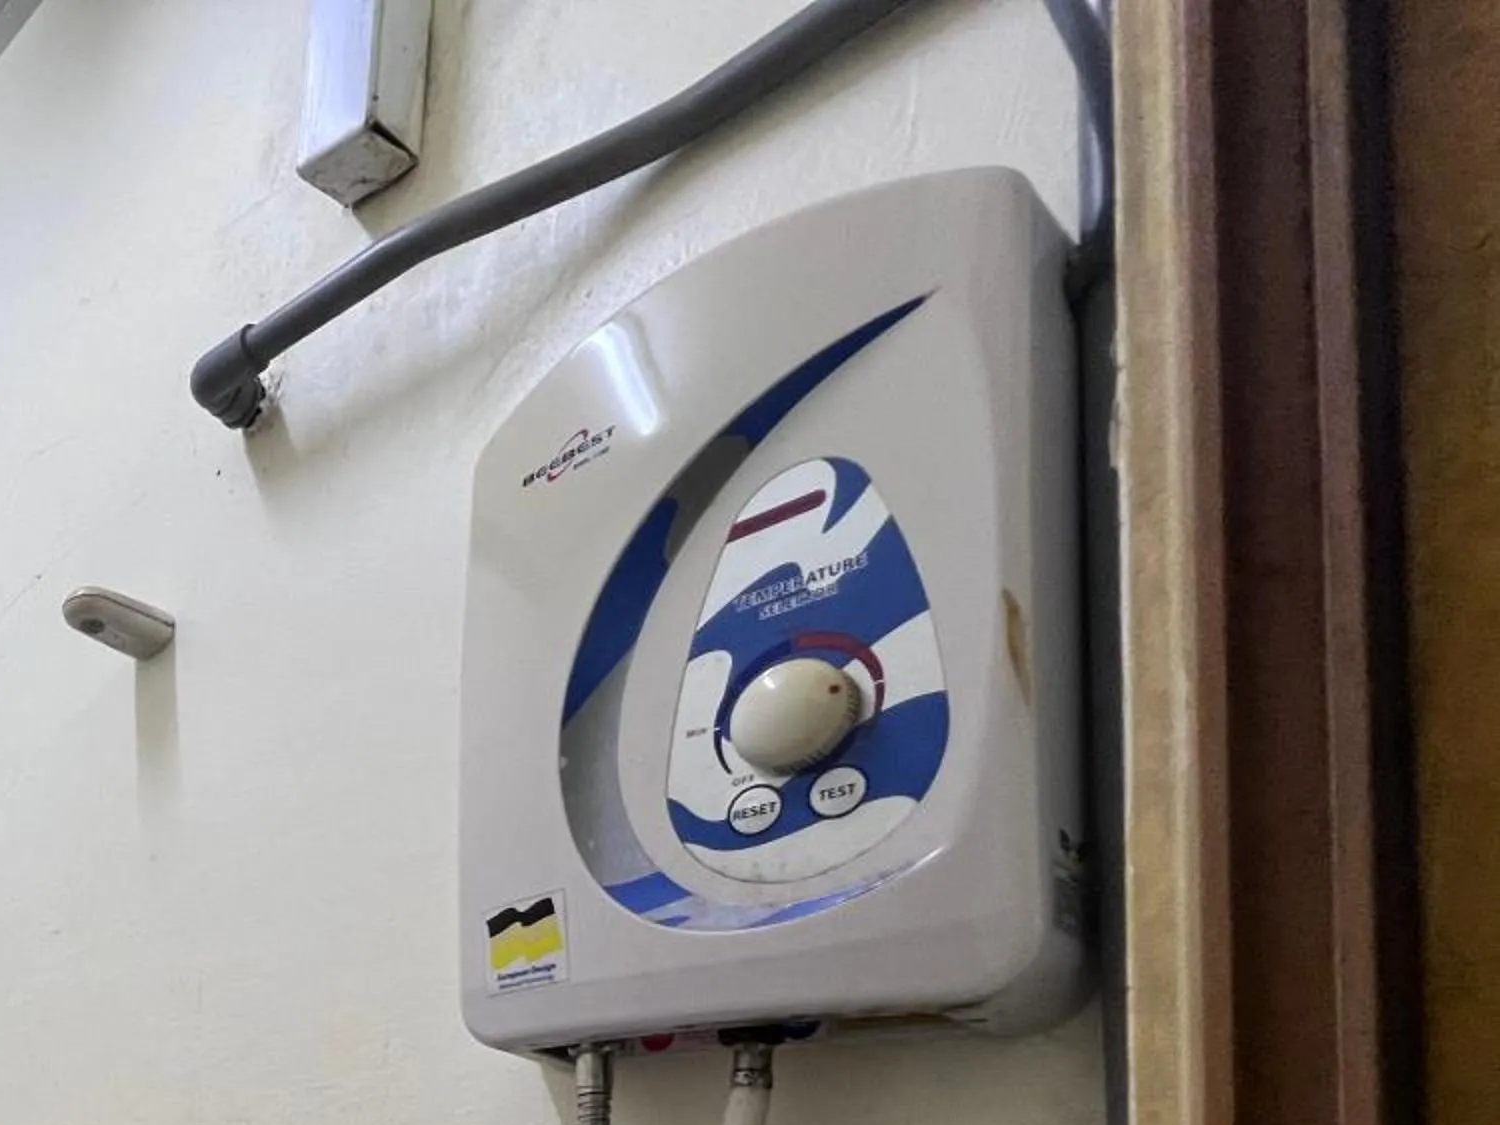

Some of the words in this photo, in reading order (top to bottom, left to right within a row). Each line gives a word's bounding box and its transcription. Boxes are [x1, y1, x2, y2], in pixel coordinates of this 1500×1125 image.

[731, 552, 868, 612] TEMPERATURE
[819, 783, 857, 801] TEST
[732, 801, 777, 821] RESET
